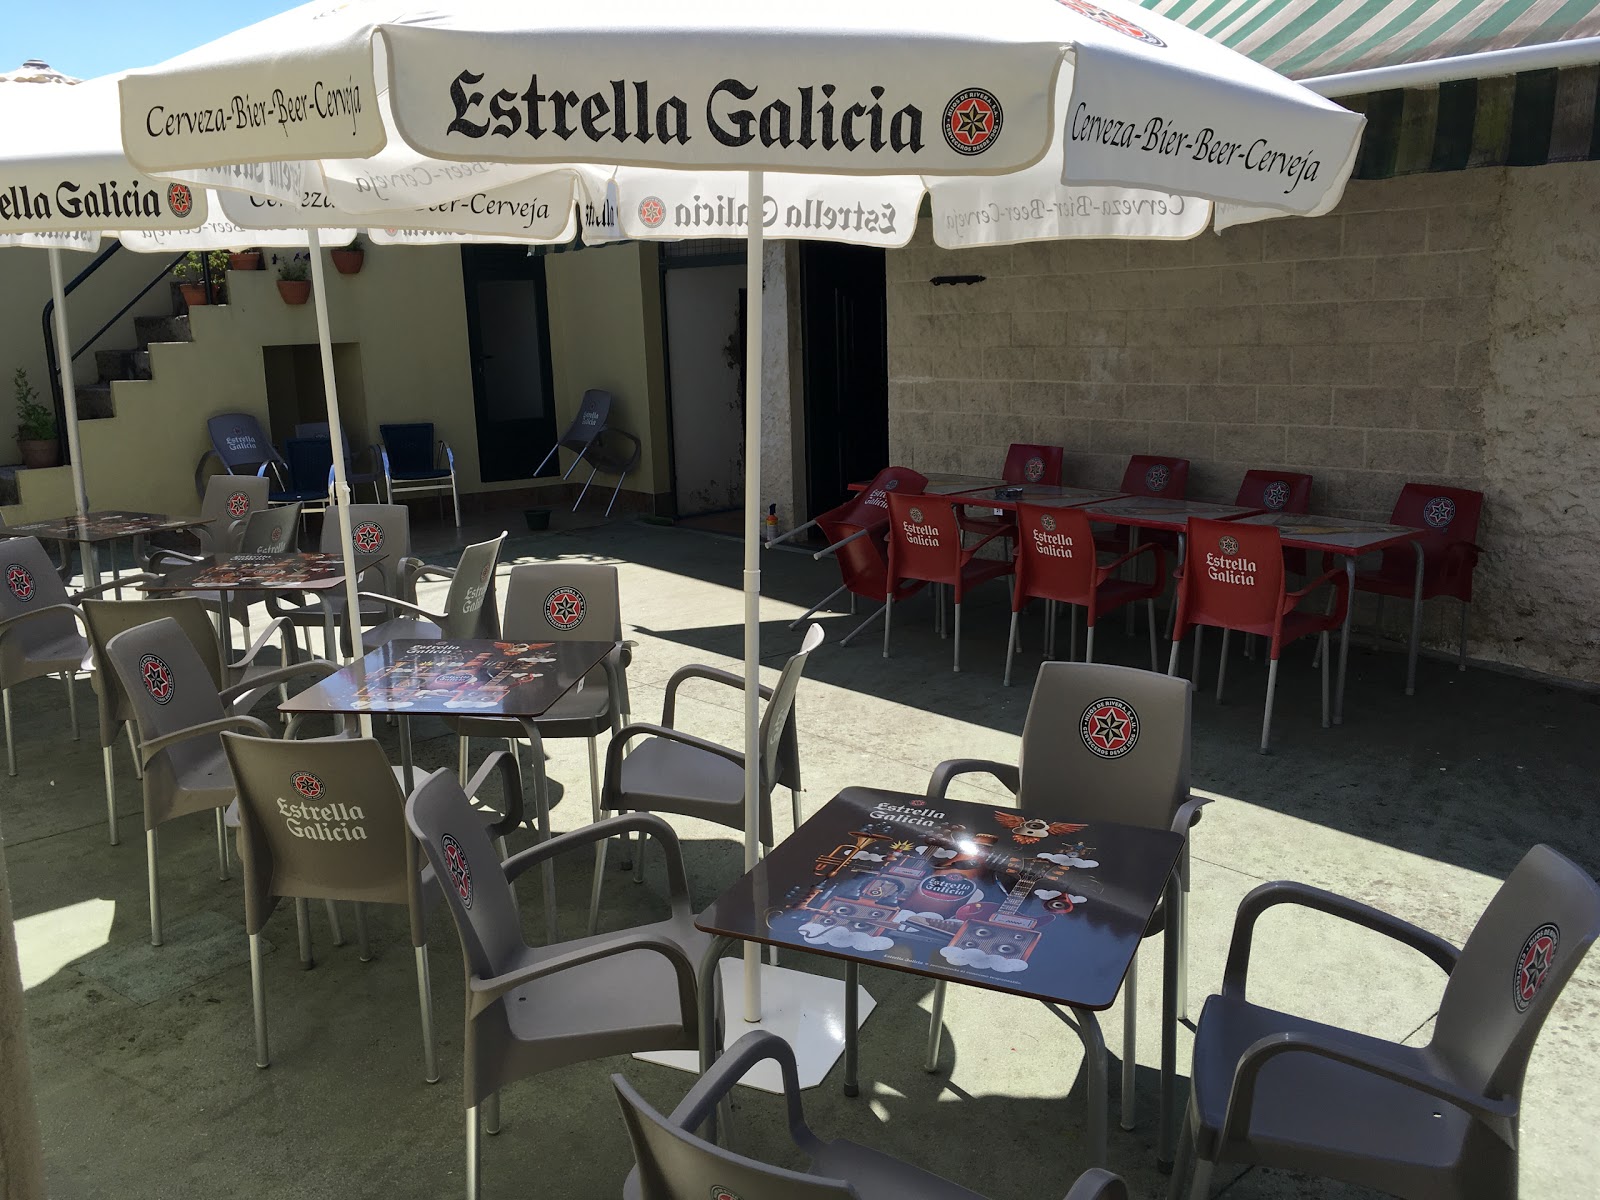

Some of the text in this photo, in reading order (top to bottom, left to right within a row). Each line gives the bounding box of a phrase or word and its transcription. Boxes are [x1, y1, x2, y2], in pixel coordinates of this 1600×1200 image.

[446, 69, 925, 154] Estrella Galicia
[1071, 101, 1322, 195] Cerveza-Bier-Beer-Cerveja
[56, 180, 162, 219] Galicia
[226, 435, 256, 445] Estrella
[229, 442, 257, 451] Galicia
[902, 520, 940, 536] Estrella
[1032, 528, 1074, 546] Estrella
[906, 531, 940, 547] Galicia
[1035, 541, 1073, 559] Galicia
[1206, 552, 1257, 573] Estrella
[1207, 566, 1255, 586] Galicia
[276, 797, 366, 821] Estrella
[873, 802, 946, 819] Estrella
[869, 810, 935, 827] Galicia
[286, 817, 368, 842] Galicia
[925, 884, 965, 896] Galicia
[928, 878, 971, 891] Estrella
